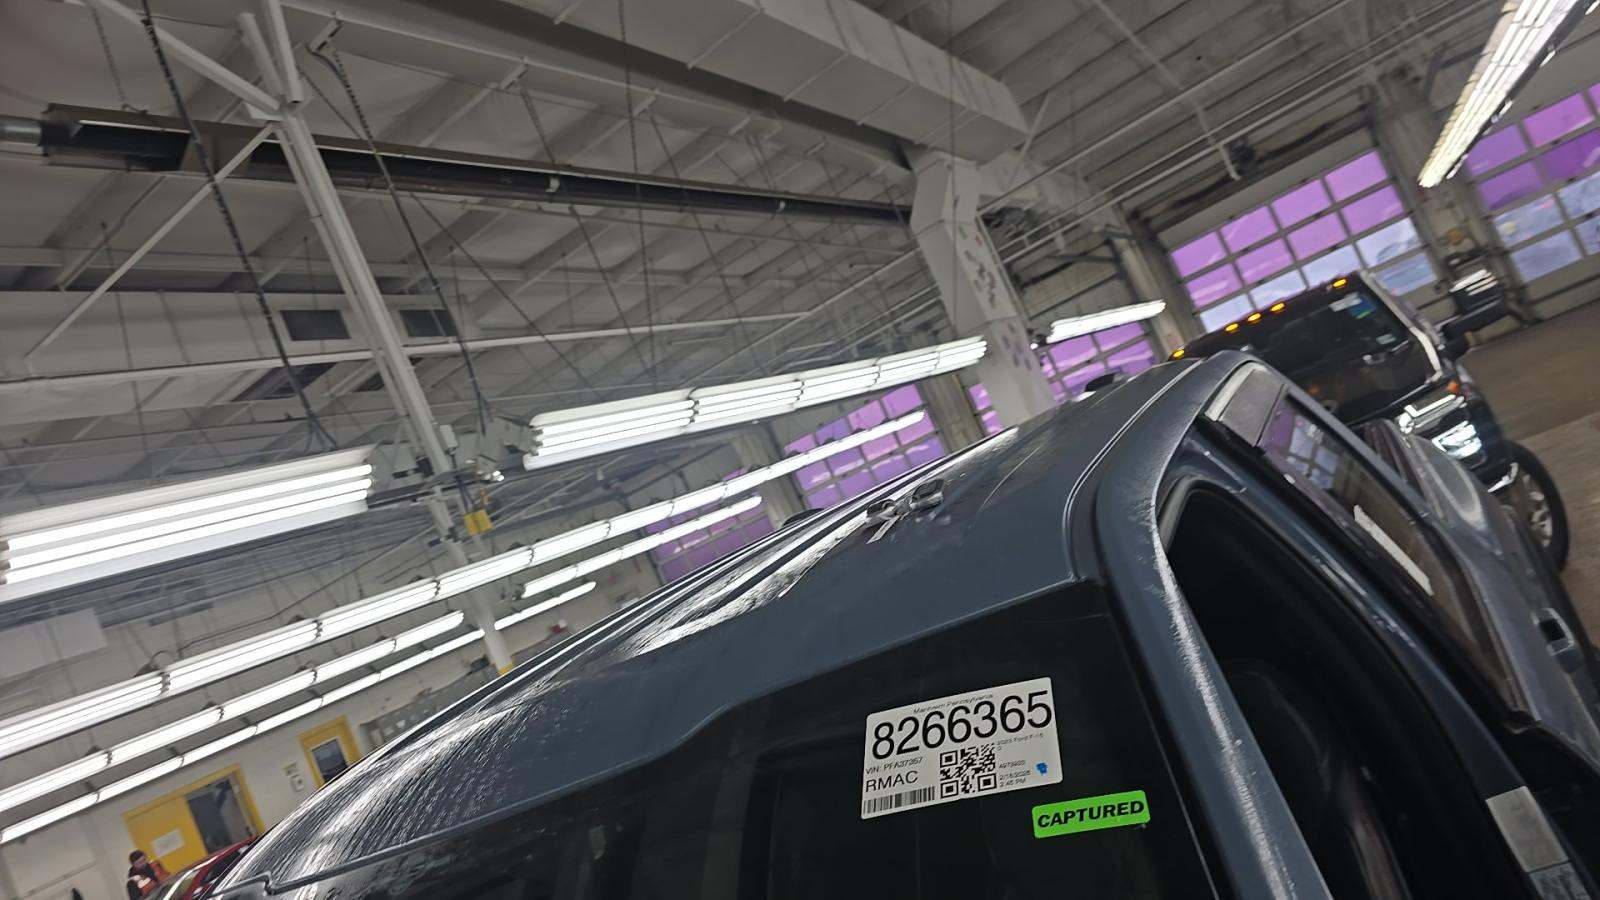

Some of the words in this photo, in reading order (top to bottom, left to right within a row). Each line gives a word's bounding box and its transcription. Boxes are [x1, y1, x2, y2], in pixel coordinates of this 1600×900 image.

[872, 690, 1052, 760] 8266365
[865, 770, 919, 793] RMAC
[1037, 800, 1145, 828] CAPTURED
